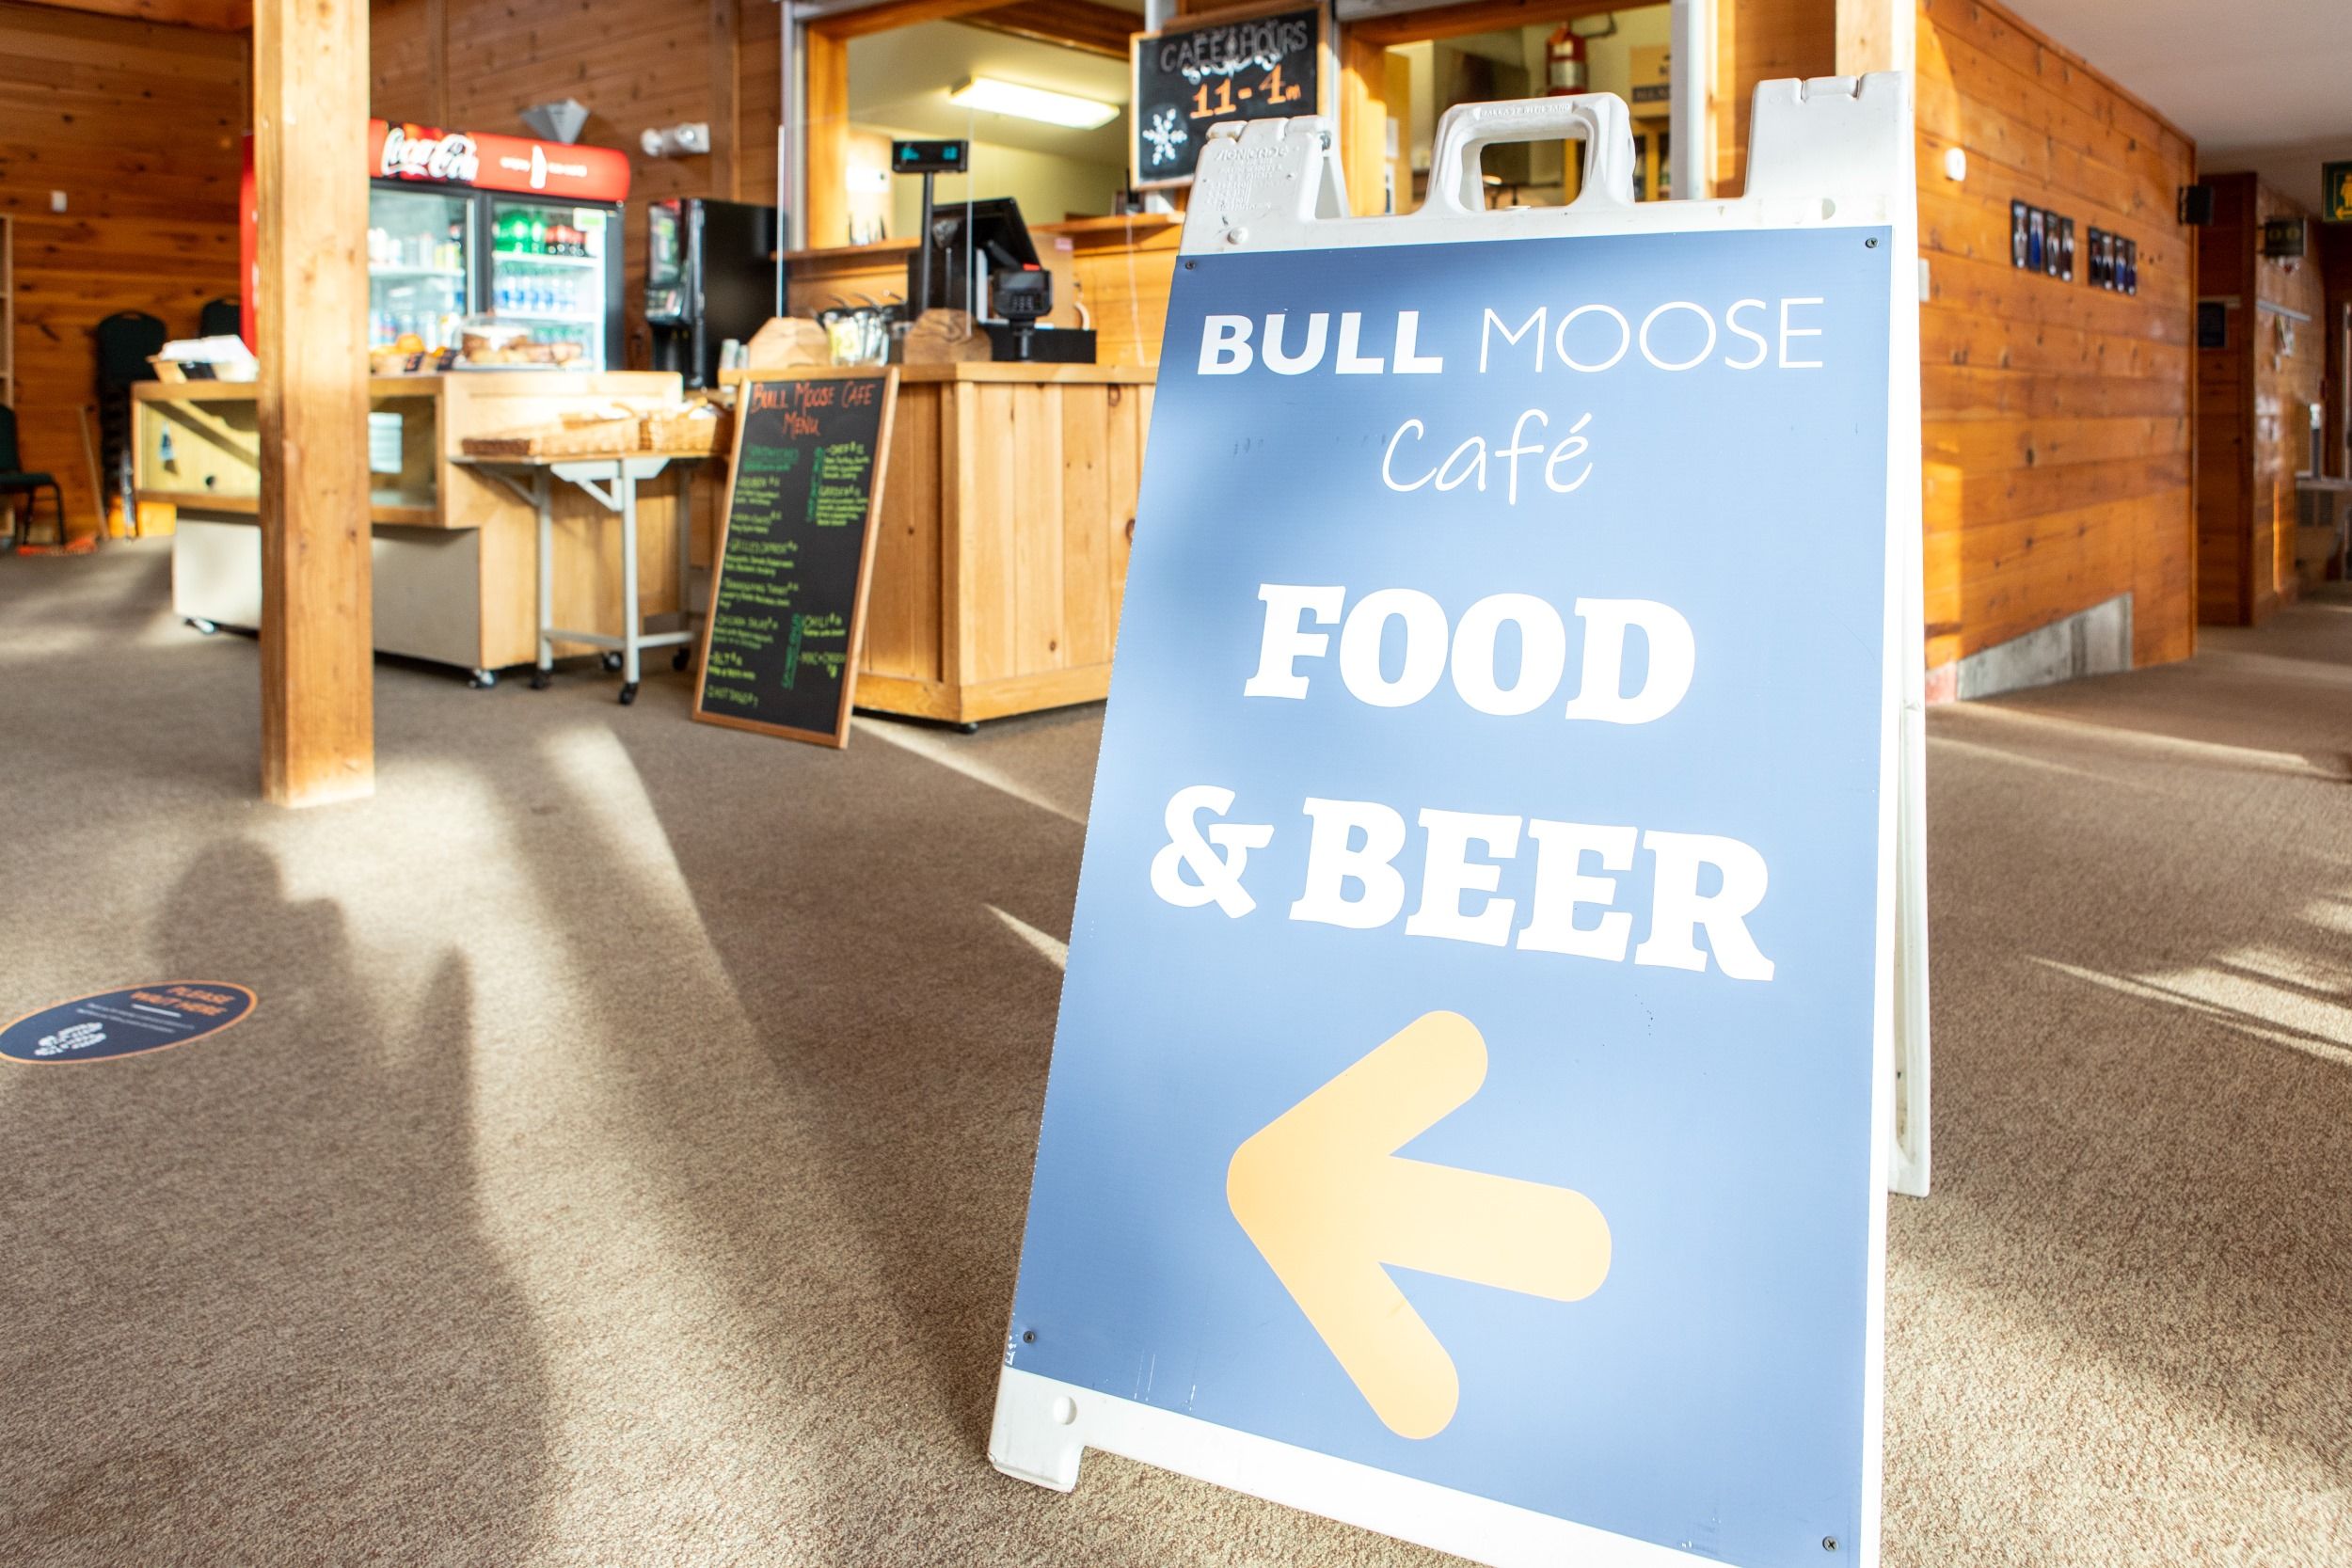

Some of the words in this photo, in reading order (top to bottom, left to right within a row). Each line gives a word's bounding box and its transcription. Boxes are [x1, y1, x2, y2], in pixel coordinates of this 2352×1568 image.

[1197, 310, 1443, 376] BULL
[1479, 297, 1823, 374] MOOSE
[794, 380, 835, 414] MOOSE
[1381, 408, 1594, 505] Café
[1243, 583, 1695, 724] FOOD
[1150, 784, 1275, 919] &
[1289, 796, 1775, 981] BEER
